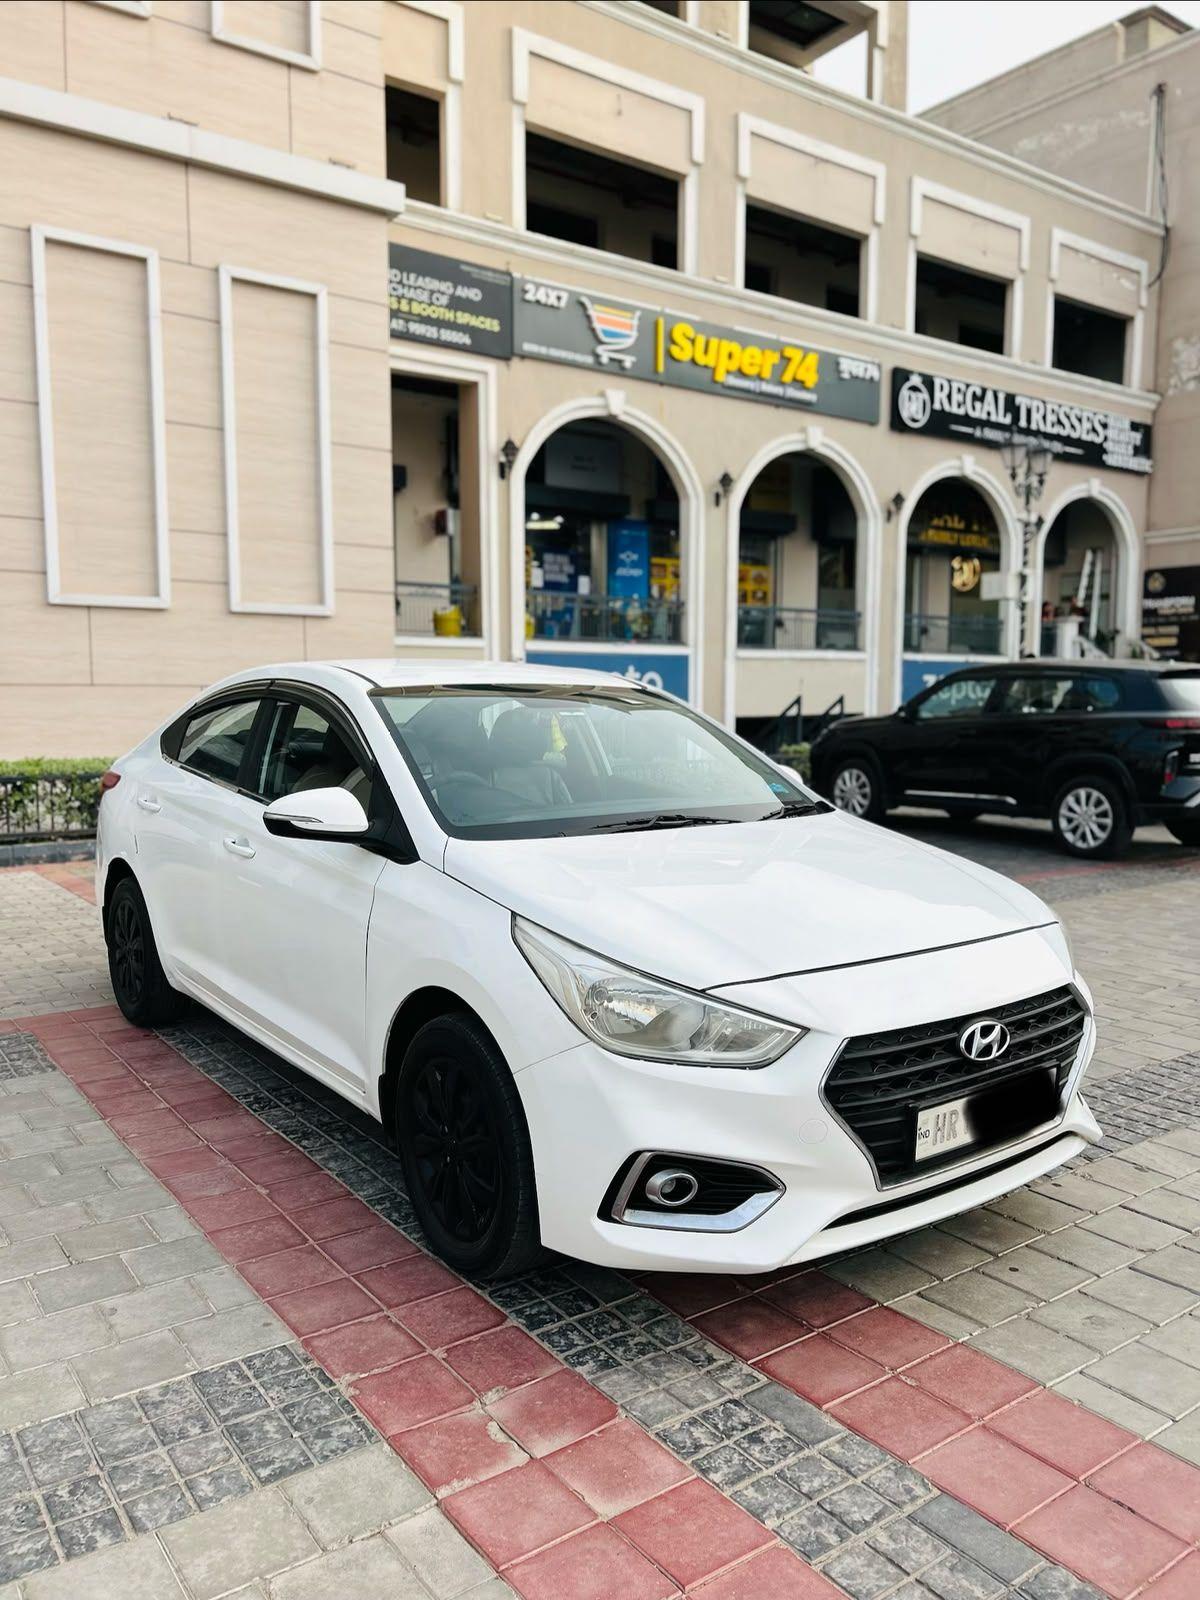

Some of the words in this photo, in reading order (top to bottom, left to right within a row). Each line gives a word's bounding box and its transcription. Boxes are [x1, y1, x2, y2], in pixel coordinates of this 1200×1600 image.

[402, 271, 455, 296] LEASING
[454, 285, 483, 302] AND
[432, 292, 450, 306] OF
[522, 282, 570, 309] 24X7
[399, 298, 410, 312] &
[411, 301, 455, 322] BOOTH
[455, 311, 501, 333] SPACES
[669, 322, 781, 383] Super
[781, 345, 820, 390] 74
[932, 376, 1012, 426] REGAL
[1014, 395, 1106, 445] TRESSES
